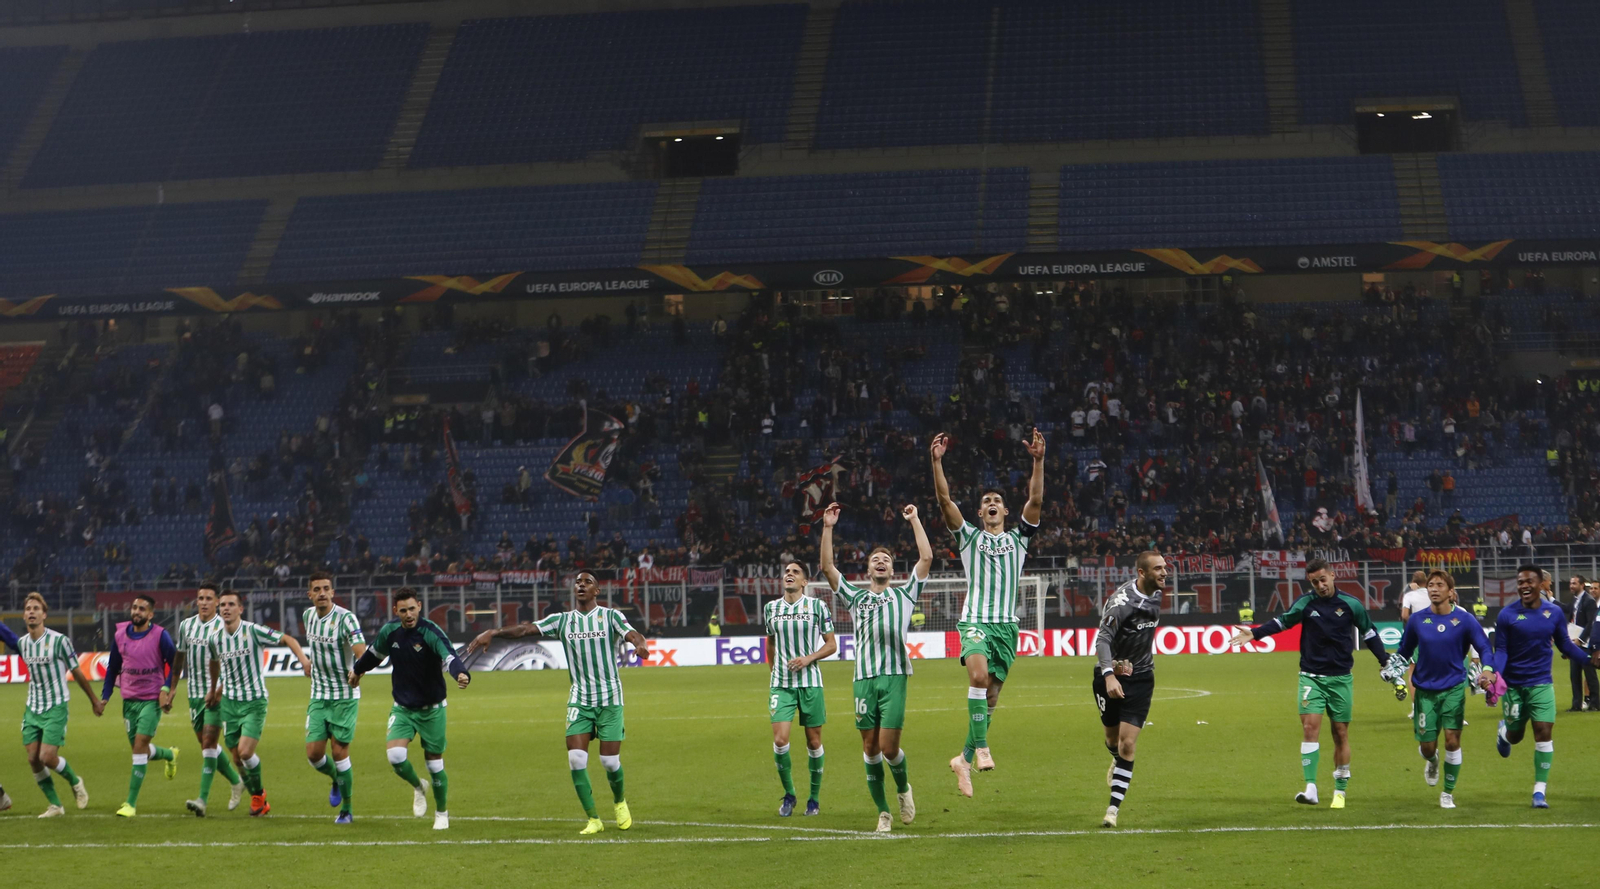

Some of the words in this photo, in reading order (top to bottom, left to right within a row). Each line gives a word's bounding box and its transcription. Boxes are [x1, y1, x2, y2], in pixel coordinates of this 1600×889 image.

[1312, 256, 1357, 268] AMSTEL
[1519, 252, 1549, 264] UEFA
[1552, 250, 1595, 263] EUROPA
[1019, 265, 1050, 275] UEFA
[1052, 264, 1097, 274] EUROPA
[1100, 262, 1145, 273] LEAGUE
[818, 272, 839, 282] KIA
[527, 283, 557, 294] UEFA
[559, 281, 603, 293] EUROPA
[606, 279, 651, 291] LEAGUE
[59, 305, 86, 316] UEFA
[89, 303, 130, 315] EUROPA
[132, 301, 175, 313] LEAGUE
[567, 630, 608, 641] OTCDESKS
[1303, 686, 1312, 700] 7
[771, 695, 780, 709] 5
[855, 697, 868, 715] 16
[1504, 702, 1520, 719] 34
[1419, 713, 1426, 728] 8
